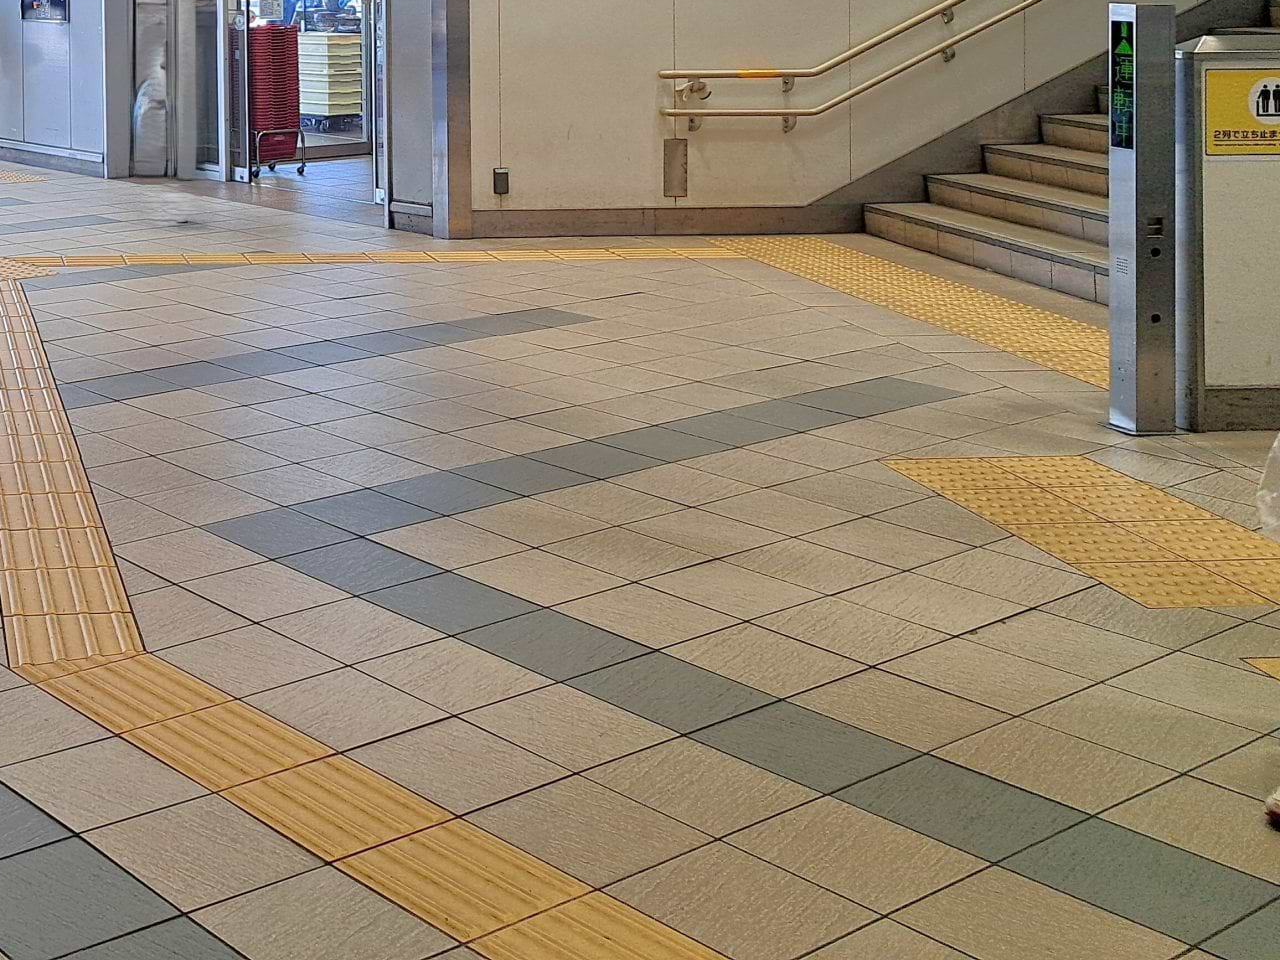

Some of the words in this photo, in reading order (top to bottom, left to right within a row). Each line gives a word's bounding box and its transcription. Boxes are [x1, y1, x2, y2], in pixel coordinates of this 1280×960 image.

[1214, 129, 1280, 139] 2列で立ち止ま
